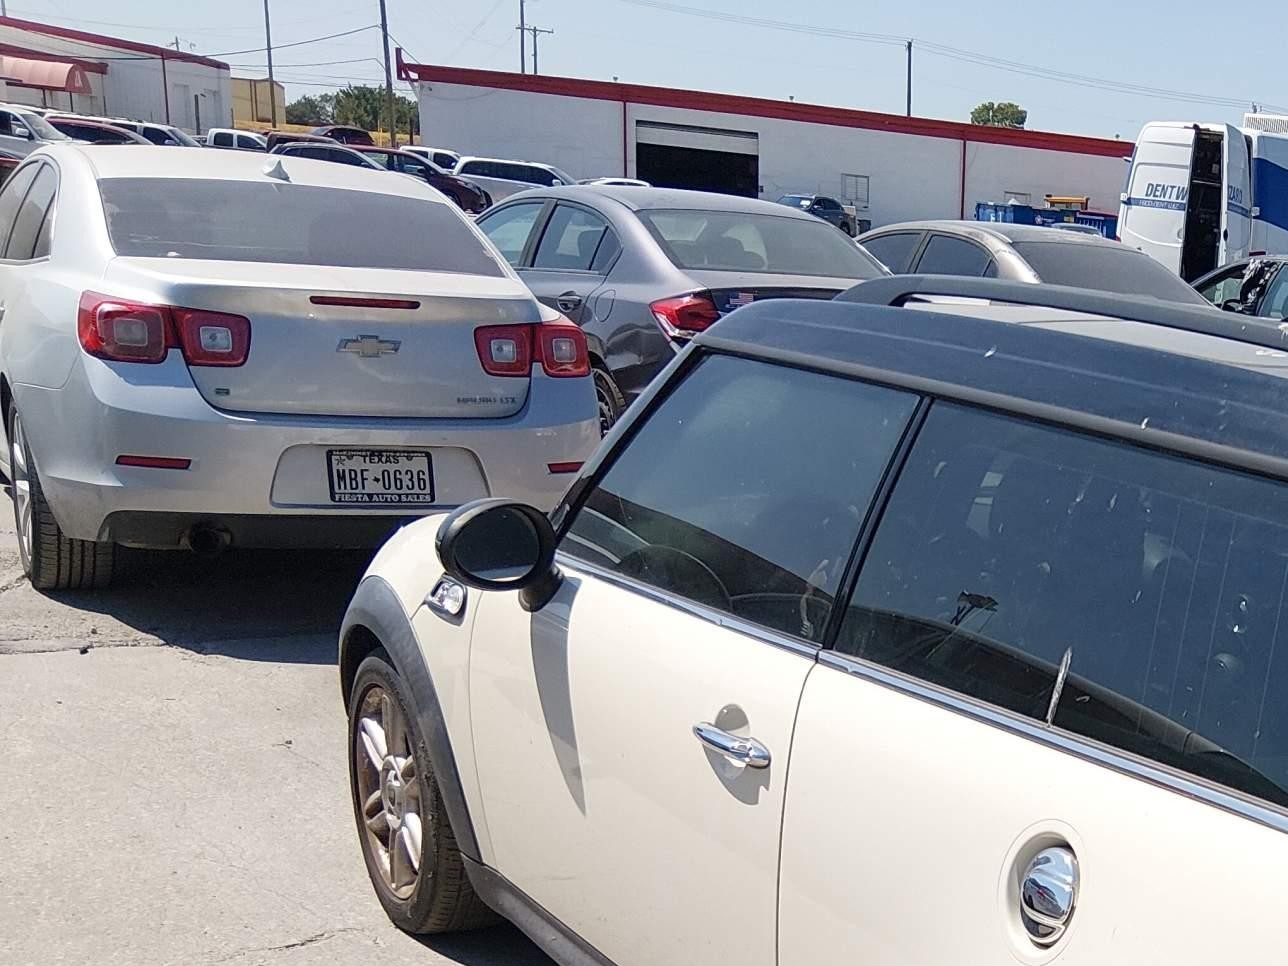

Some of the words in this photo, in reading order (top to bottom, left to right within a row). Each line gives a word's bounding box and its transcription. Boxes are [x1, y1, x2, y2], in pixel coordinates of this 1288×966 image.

[362, 453, 400, 464] TEXAS
[336, 468, 369, 490] MBF
[381, 469, 427, 491] 0636
[335, 494, 369, 502] FIESTA
[373, 494, 400, 502] AUTO
[401, 494, 430, 502] SALES
